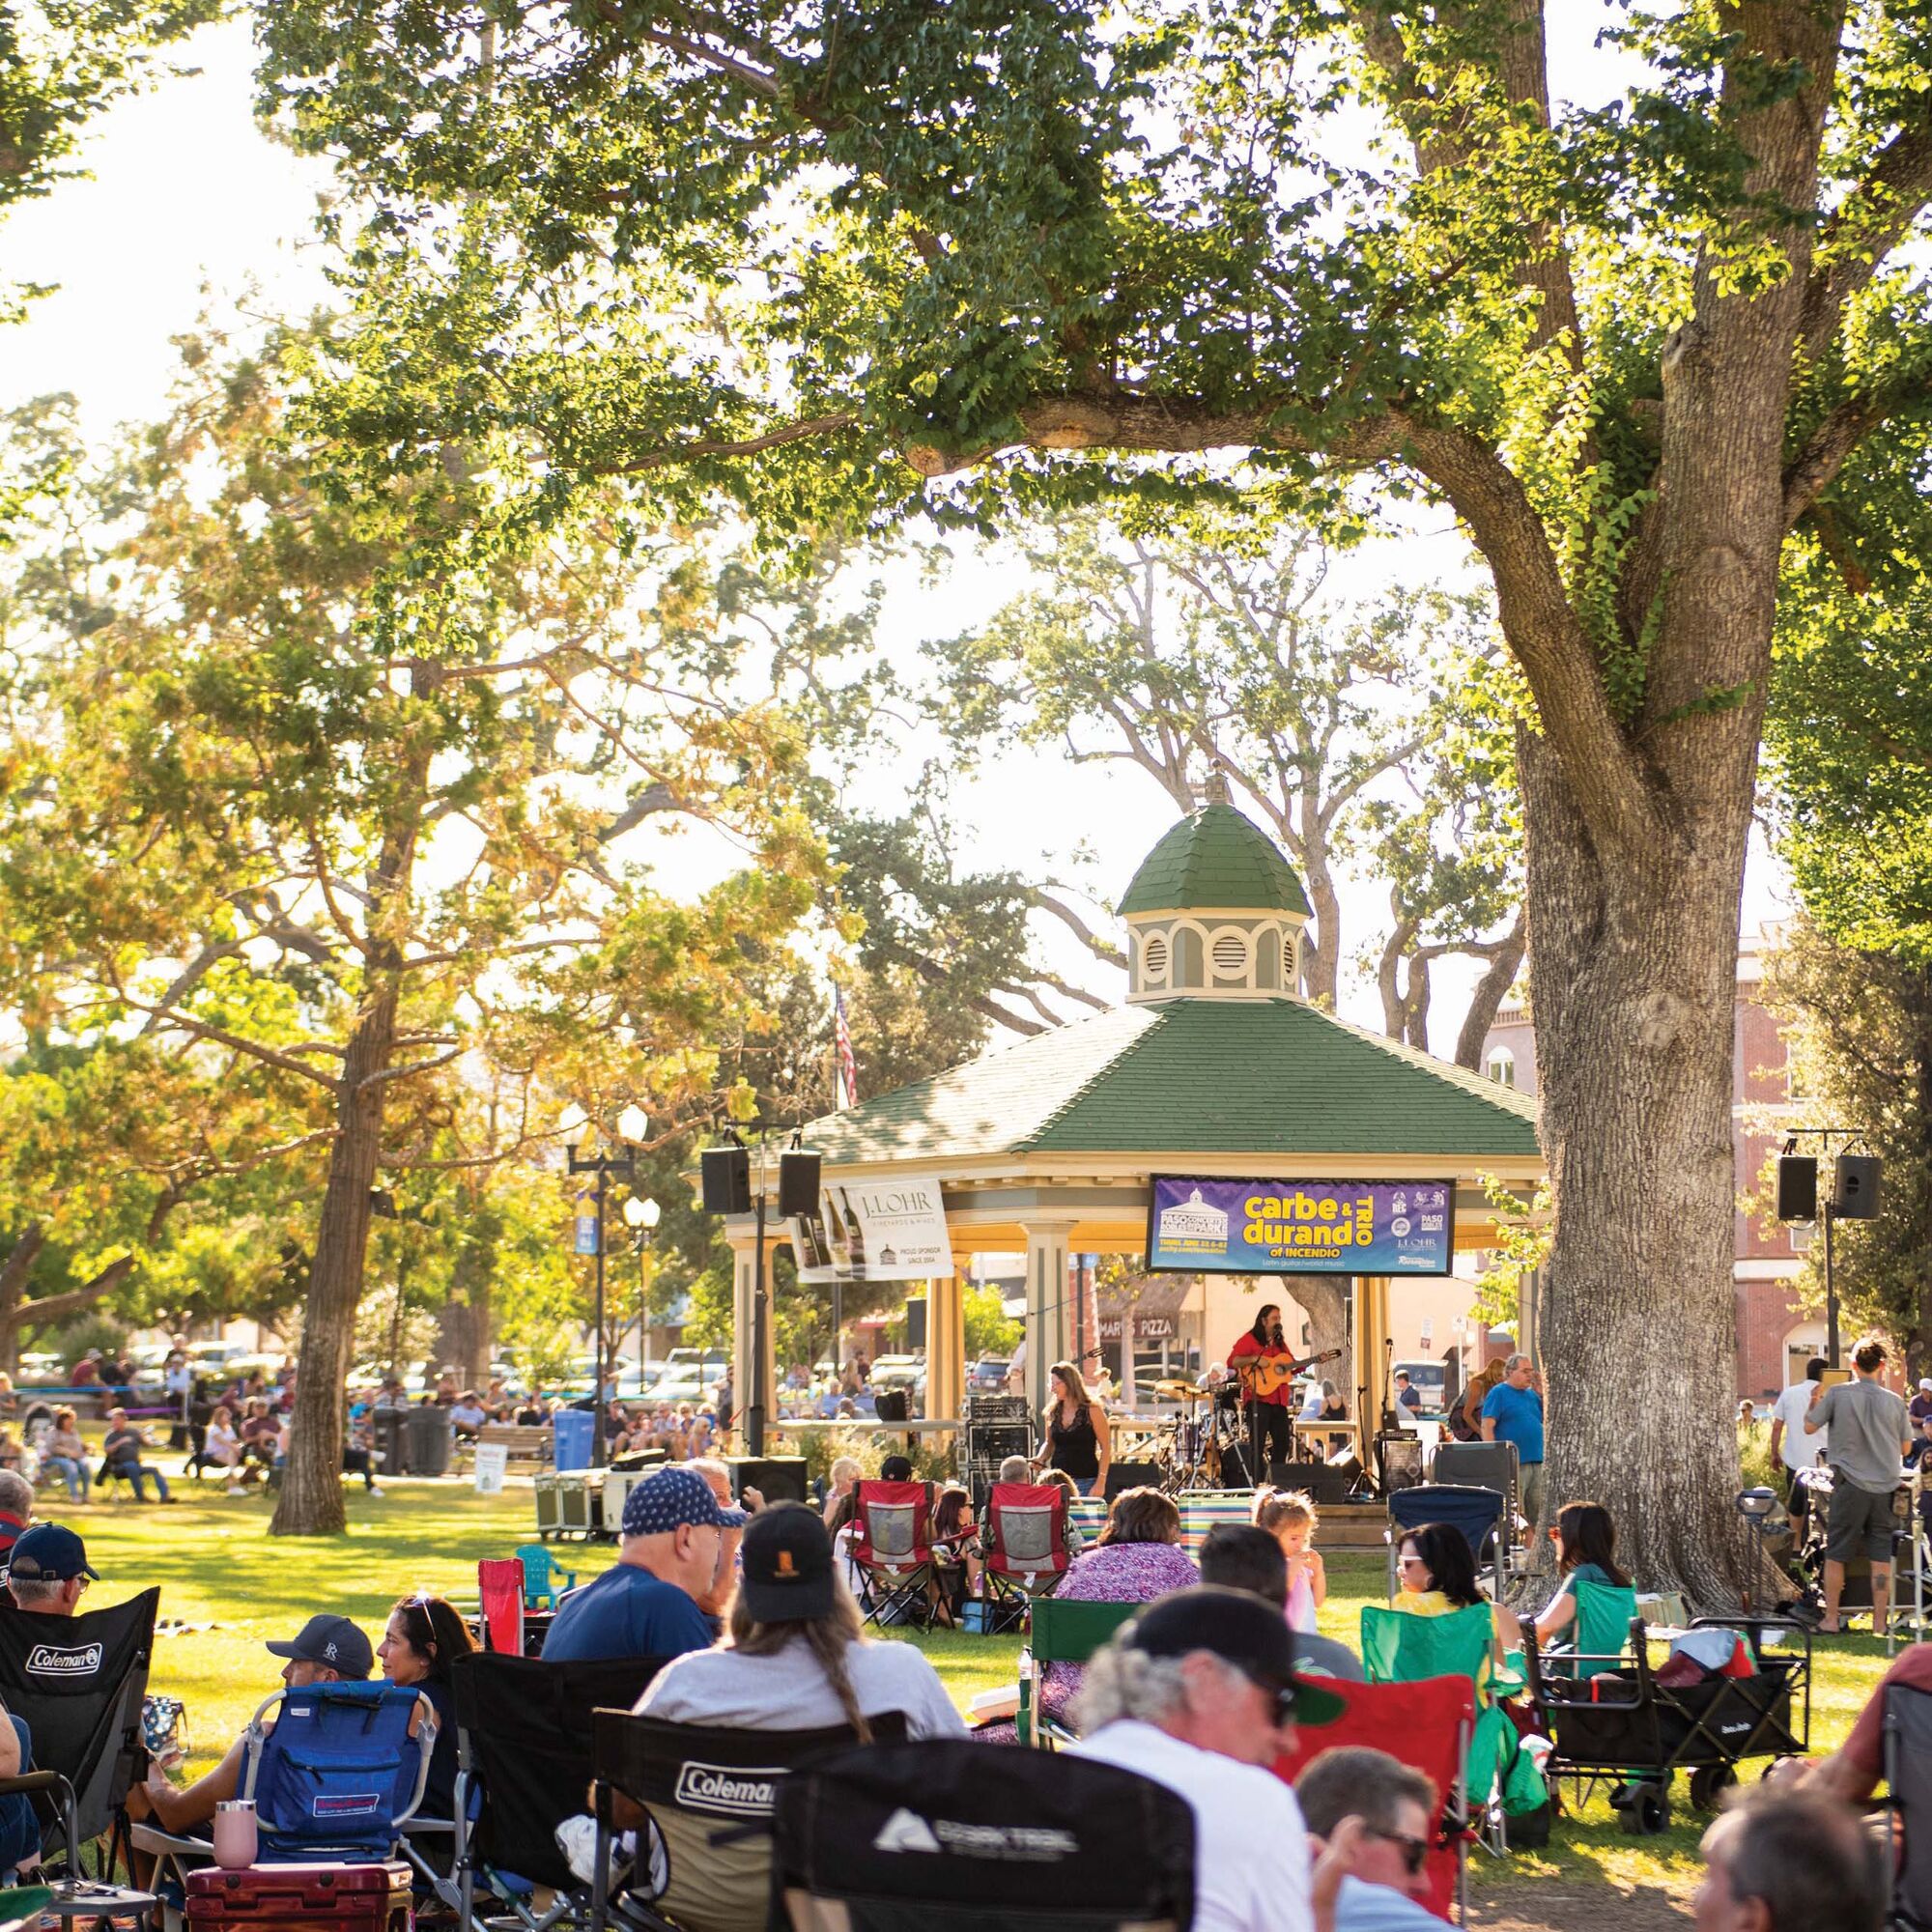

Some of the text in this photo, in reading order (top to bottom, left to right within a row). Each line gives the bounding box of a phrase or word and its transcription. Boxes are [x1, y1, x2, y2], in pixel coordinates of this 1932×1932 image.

[1244, 1191, 1352, 1220] carbe &
[1243, 1218, 1352, 1246] durand
[1355, 1195, 1374, 1246] TRIO
[1270, 1247, 1341, 1259] of INCENDIO
[1141, 1320, 1172, 1336] PIZZA
[35, 1649, 85, 1667] Coleman
